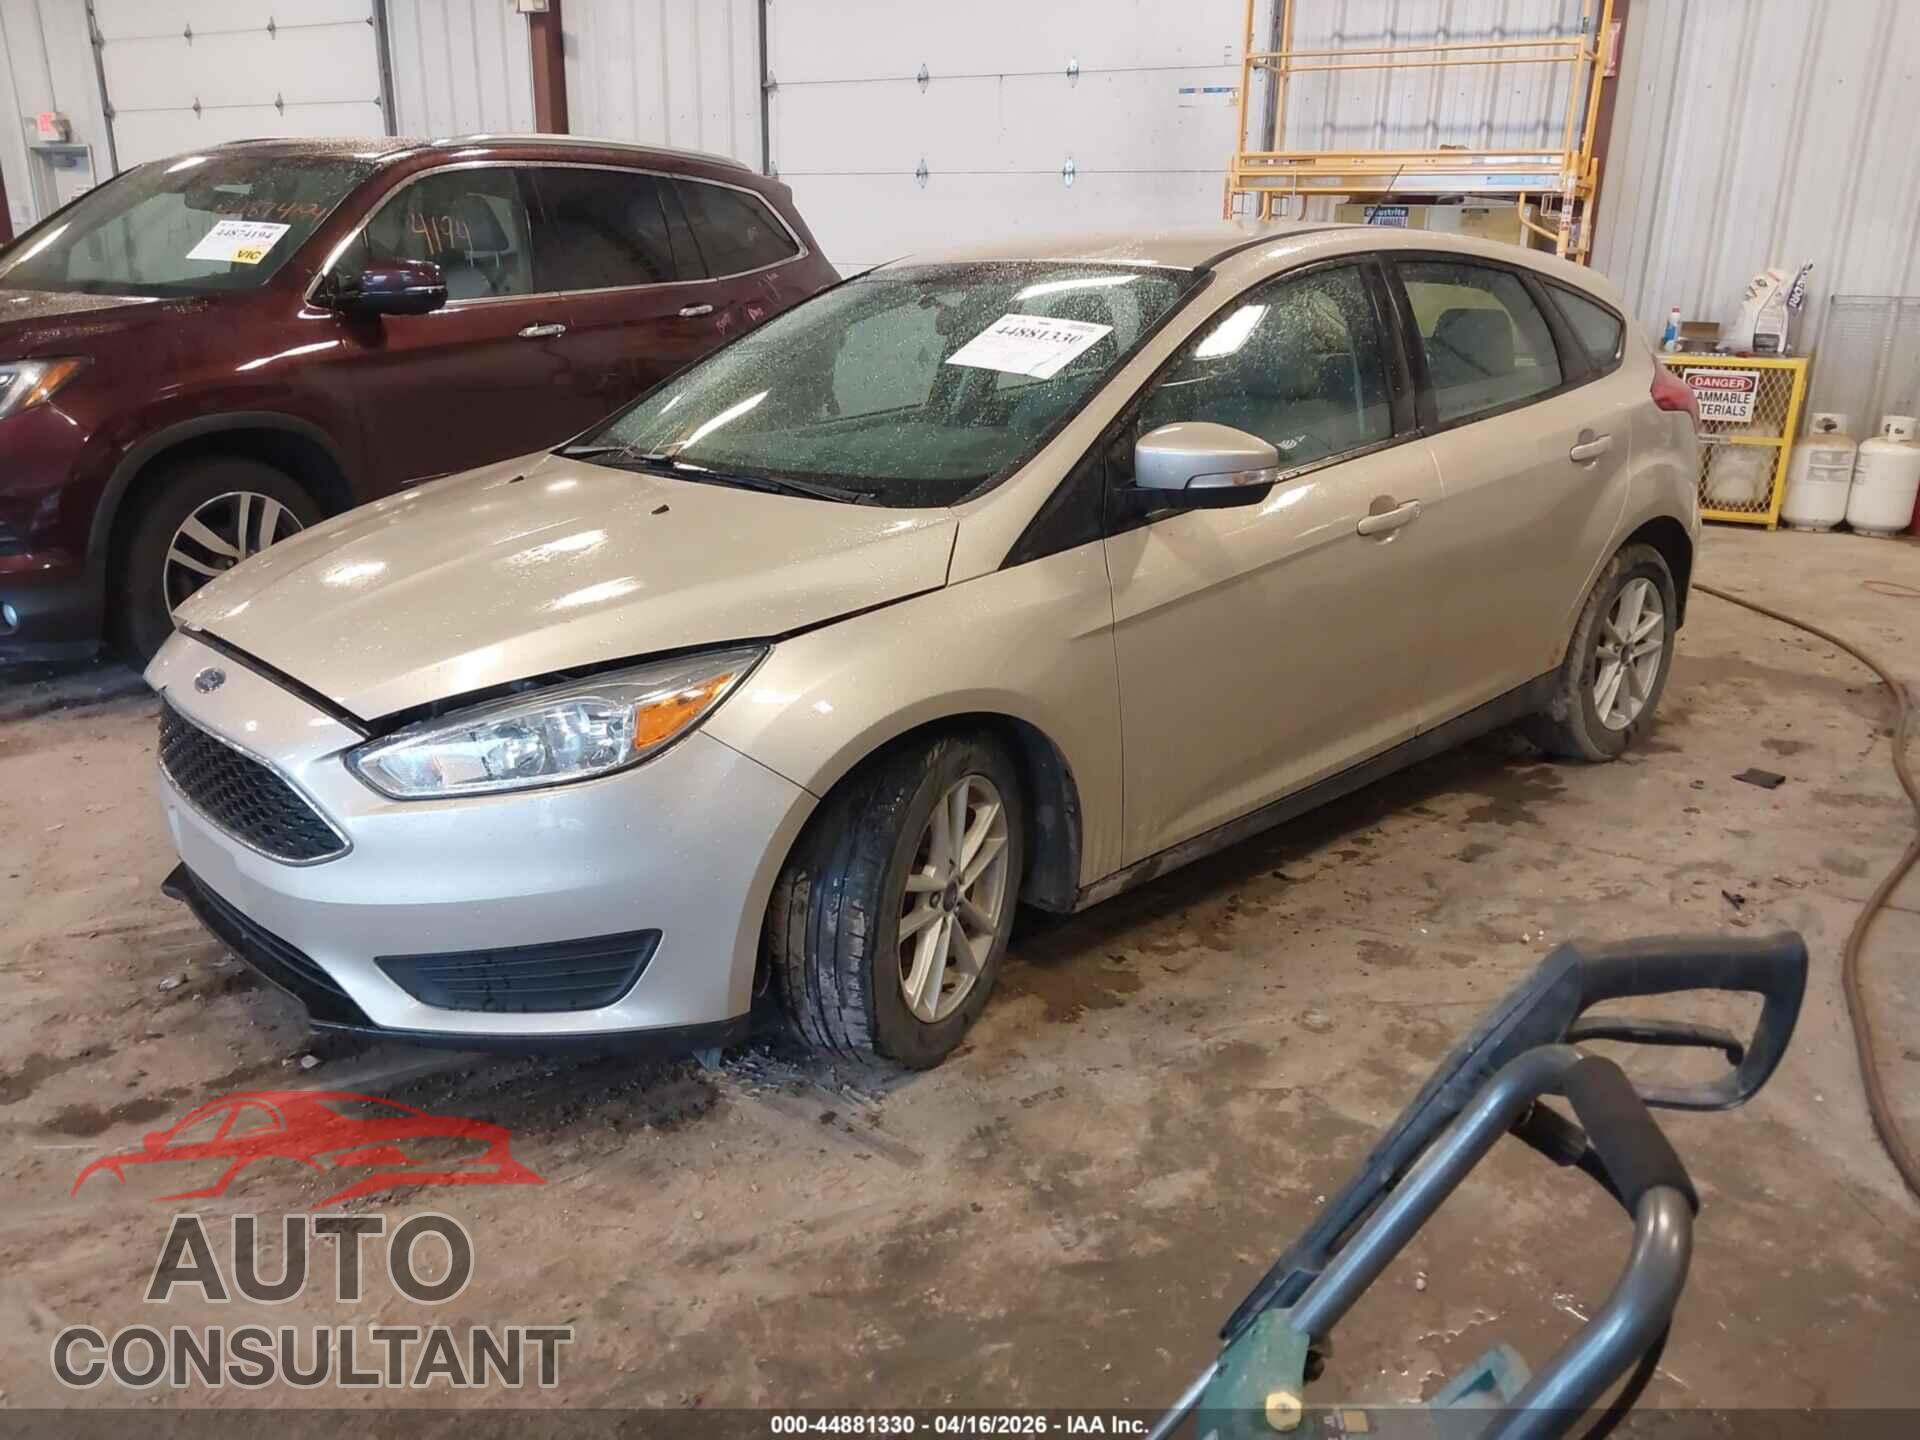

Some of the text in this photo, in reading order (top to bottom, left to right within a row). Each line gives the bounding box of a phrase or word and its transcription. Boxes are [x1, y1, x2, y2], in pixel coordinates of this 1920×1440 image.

[1377, 208, 1406, 216] ustrite
[996, 326, 1083, 344] 44881330
[1694, 377, 1745, 388] DANGER
[1697, 391, 1751, 404] AMMABLE
[1701, 404, 1746, 417] TERIALS
